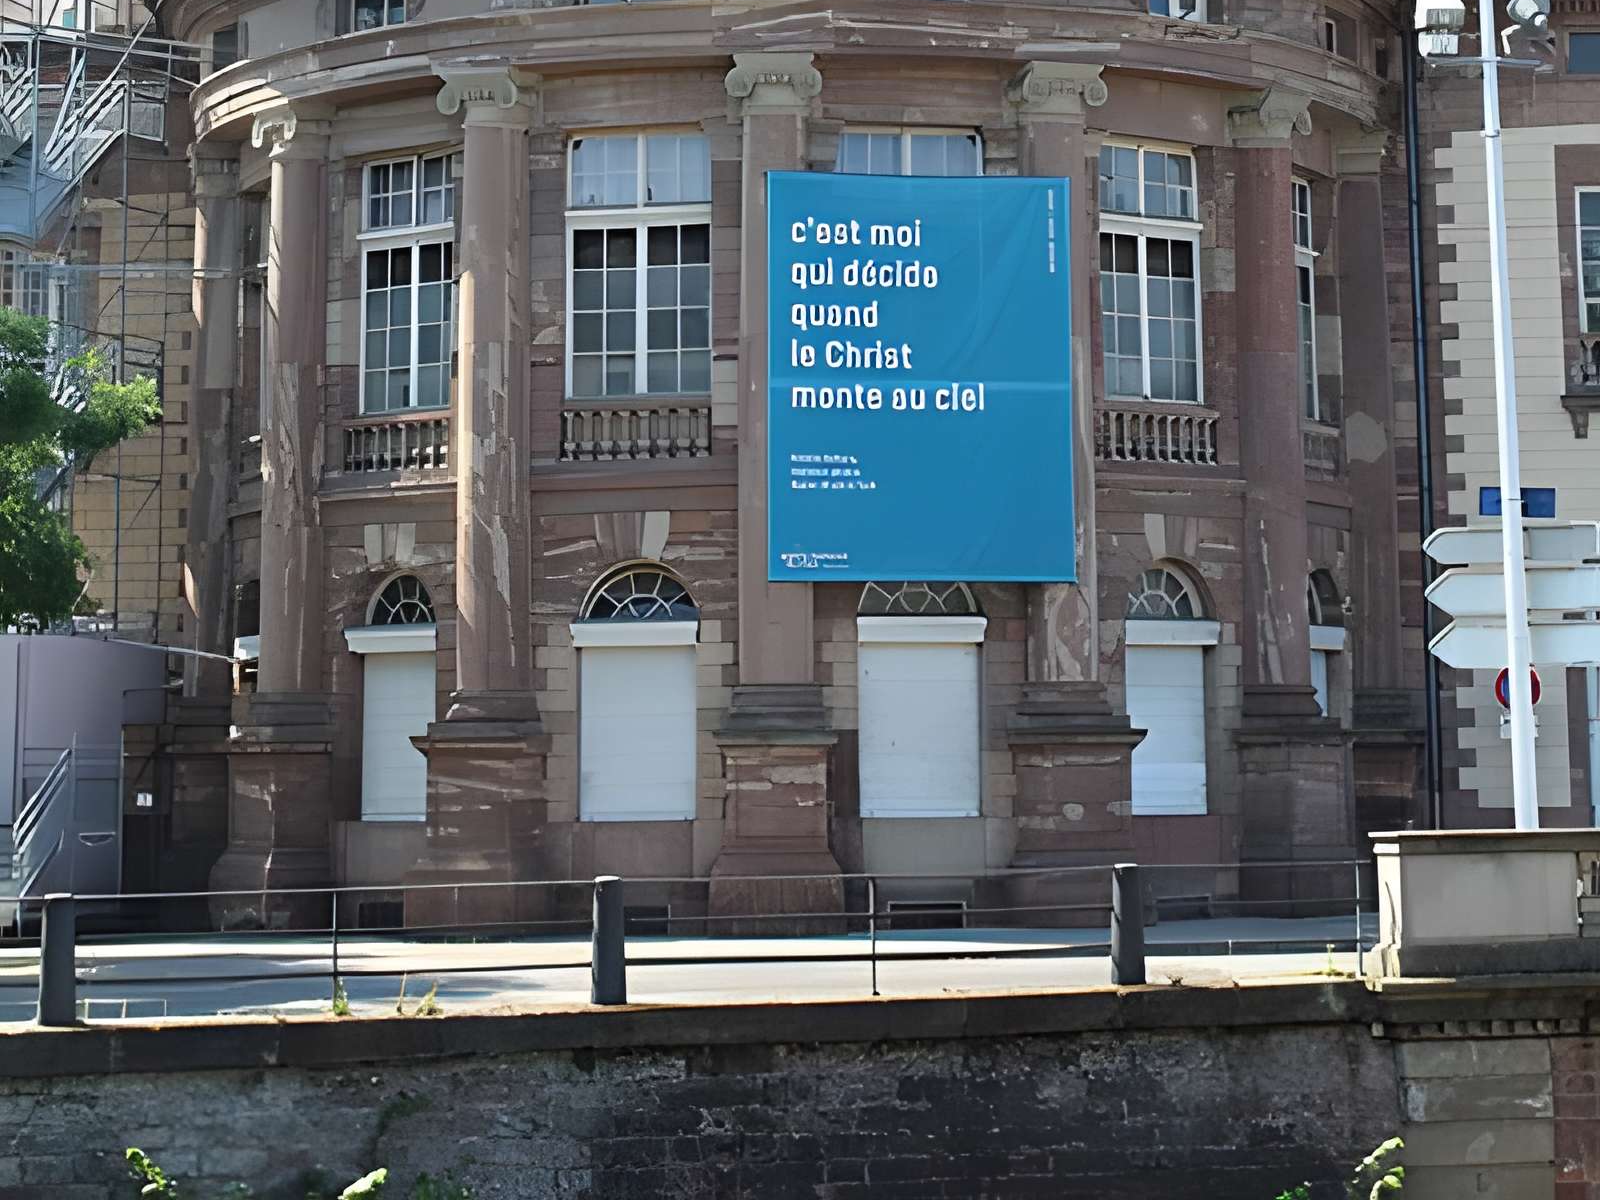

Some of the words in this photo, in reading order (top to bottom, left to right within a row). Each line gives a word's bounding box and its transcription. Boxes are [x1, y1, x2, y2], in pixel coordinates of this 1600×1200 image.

[870, 219, 921, 247] moi
[825, 339, 913, 369] Christ
[791, 383, 883, 410] monte
[891, 387, 926, 411] au
[935, 382, 985, 411] ciel
